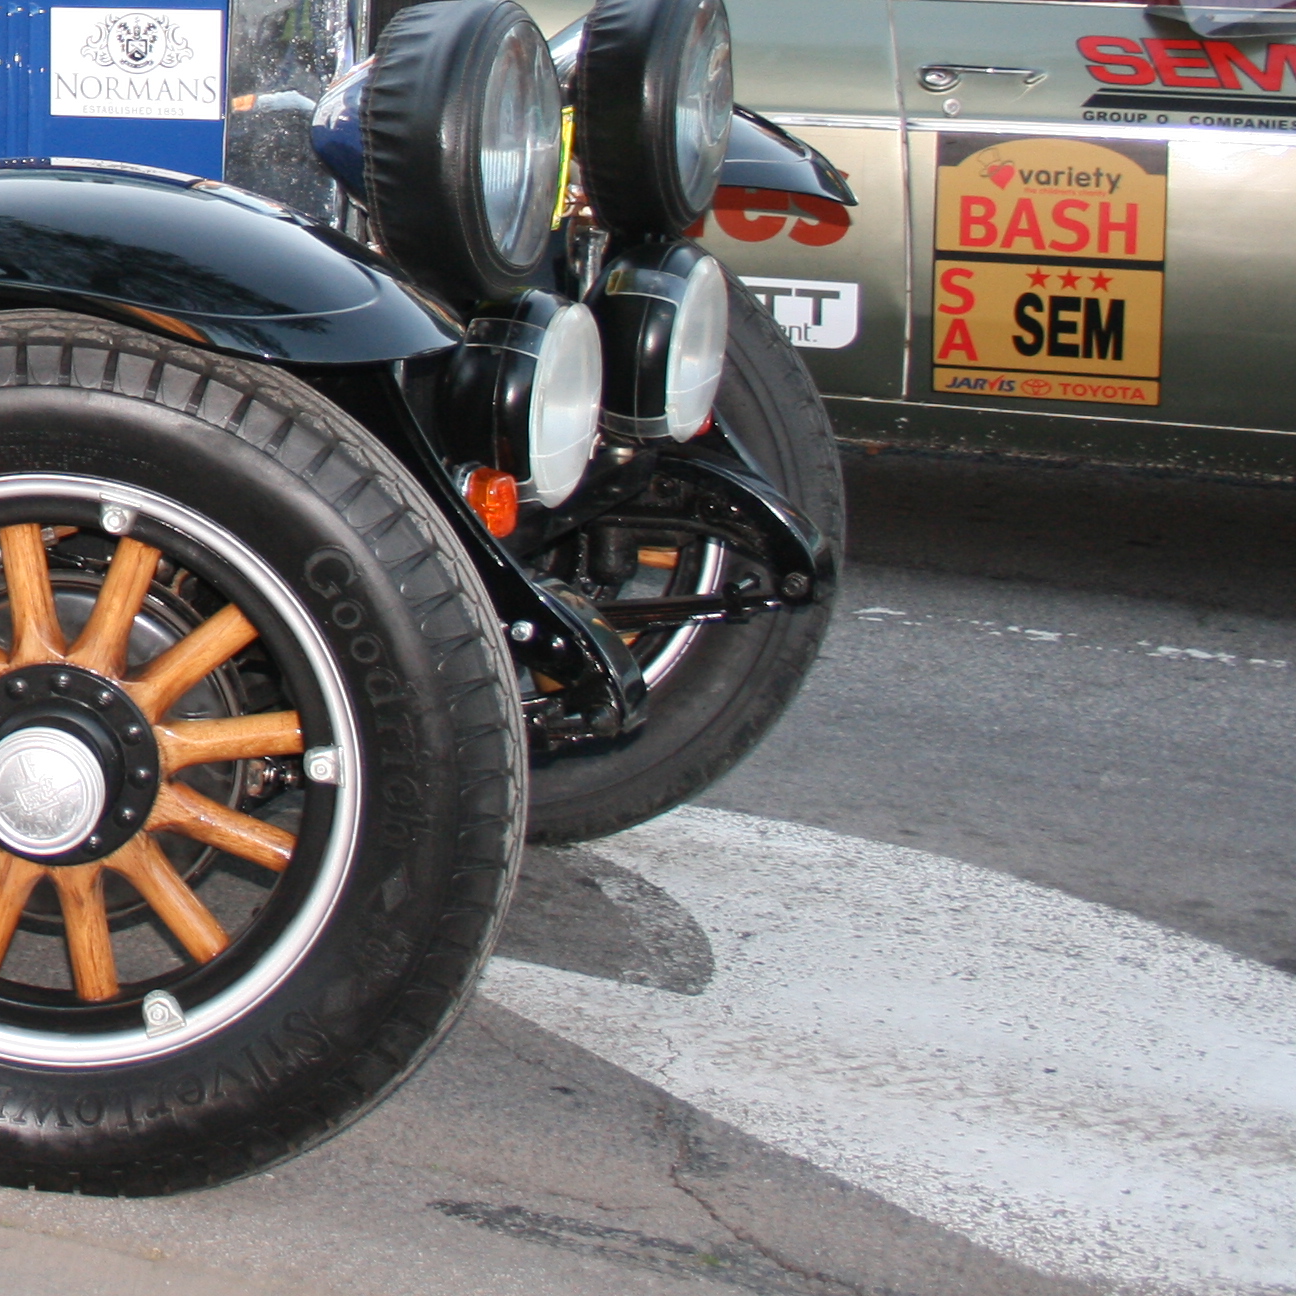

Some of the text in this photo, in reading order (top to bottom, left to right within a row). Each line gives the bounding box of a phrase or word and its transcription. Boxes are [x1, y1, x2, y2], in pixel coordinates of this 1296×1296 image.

[82, 105, 185, 117] ESTABLISHED 1853
[1082, 110, 1148, 124] GROUP
[1018, 166, 1122, 194] variety
[681, 169, 853, 247] es
[959, 195, 1139, 255] BASH
[1012, 292, 1126, 361] SEM
[945, 375, 1146, 401] JARVIS TOYOTA
[304, 544, 430, 851] Goodrich
